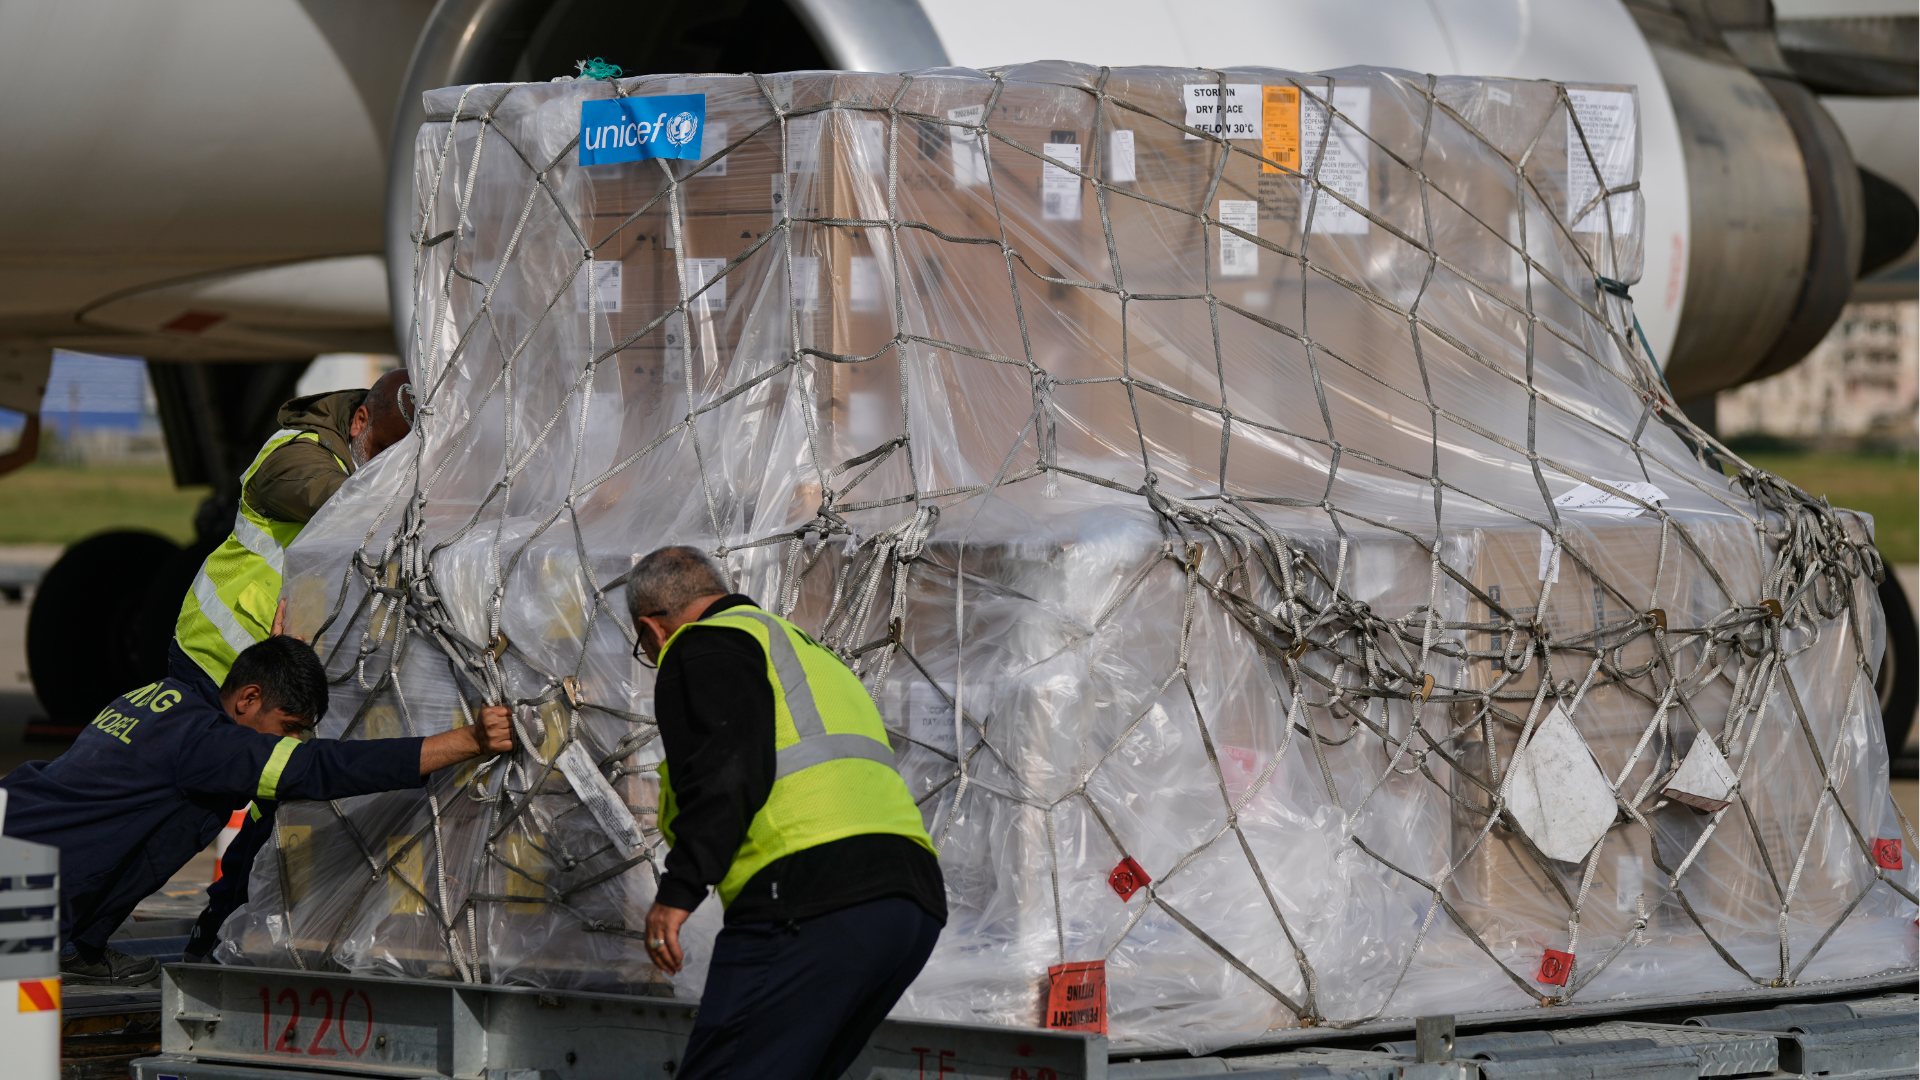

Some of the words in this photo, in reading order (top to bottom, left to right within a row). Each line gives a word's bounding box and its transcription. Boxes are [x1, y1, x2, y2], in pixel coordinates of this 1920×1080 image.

[1226, 88, 1236, 97] IN
[1196, 105, 1214, 114] DRY
[1216, 104, 1243, 114] PACE
[585, 112, 668, 151] unicef
[1067, 982, 1096, 1001] FITTING
[259, 986, 373, 1057] 1220
